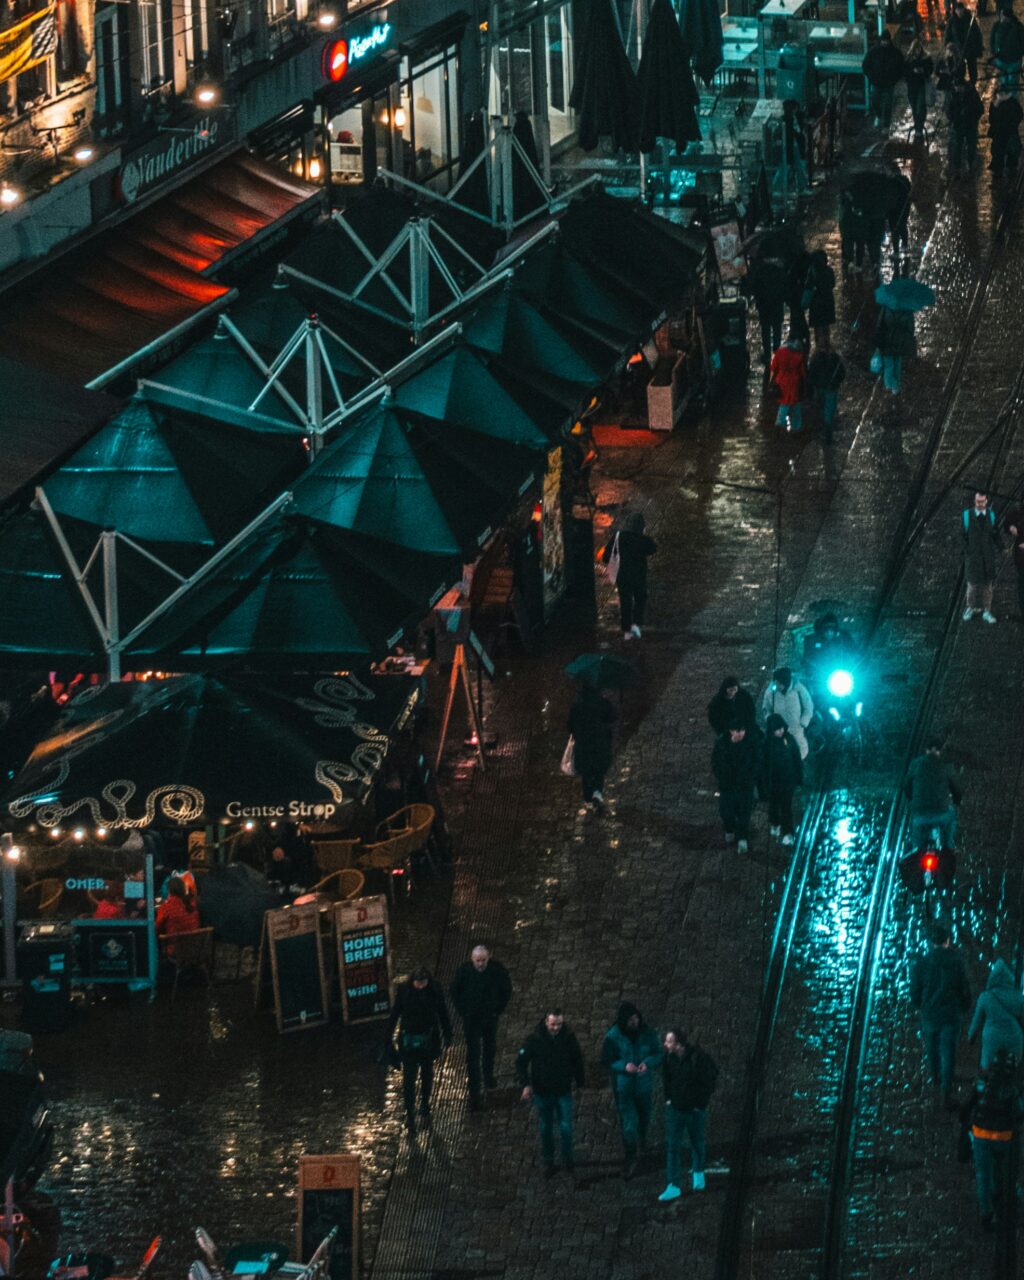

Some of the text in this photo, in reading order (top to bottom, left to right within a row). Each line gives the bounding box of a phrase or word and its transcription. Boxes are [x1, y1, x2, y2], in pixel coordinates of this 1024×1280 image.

[138, 116, 218, 185] Vaudeville
[226, 800, 335, 819] Gentse Strop
[344, 934, 384, 951] HOME
[345, 946, 384, 964] BREW
